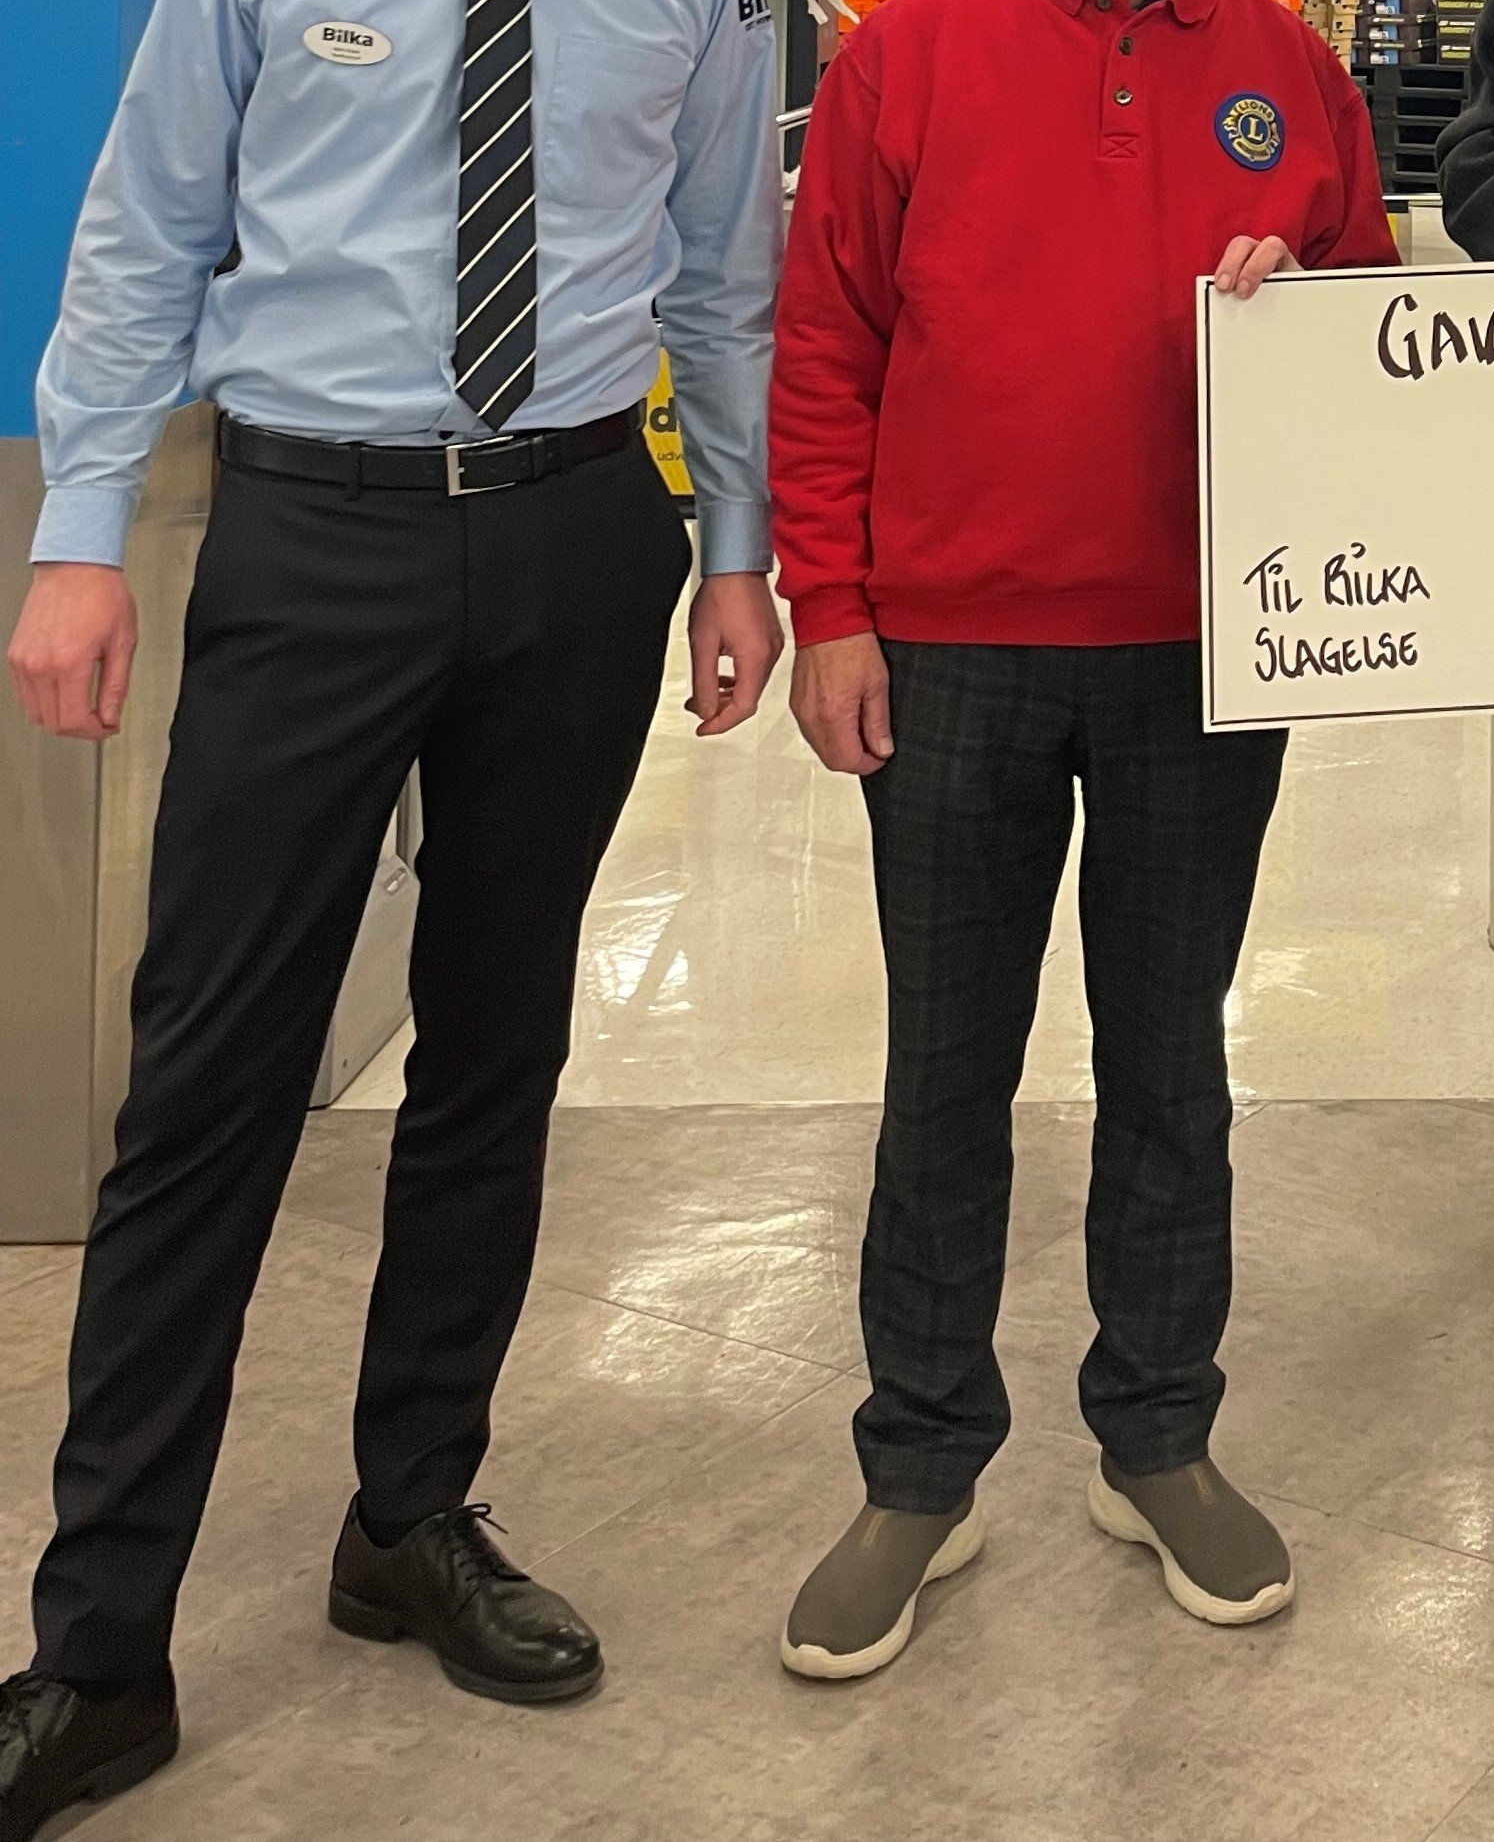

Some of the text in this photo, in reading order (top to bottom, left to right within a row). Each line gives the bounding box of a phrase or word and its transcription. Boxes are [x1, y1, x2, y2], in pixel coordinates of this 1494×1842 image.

[323, 27, 374, 47] Bilka
[1247, 117, 1263, 141] L
[1255, 626, 1419, 682] SLAGELSE
